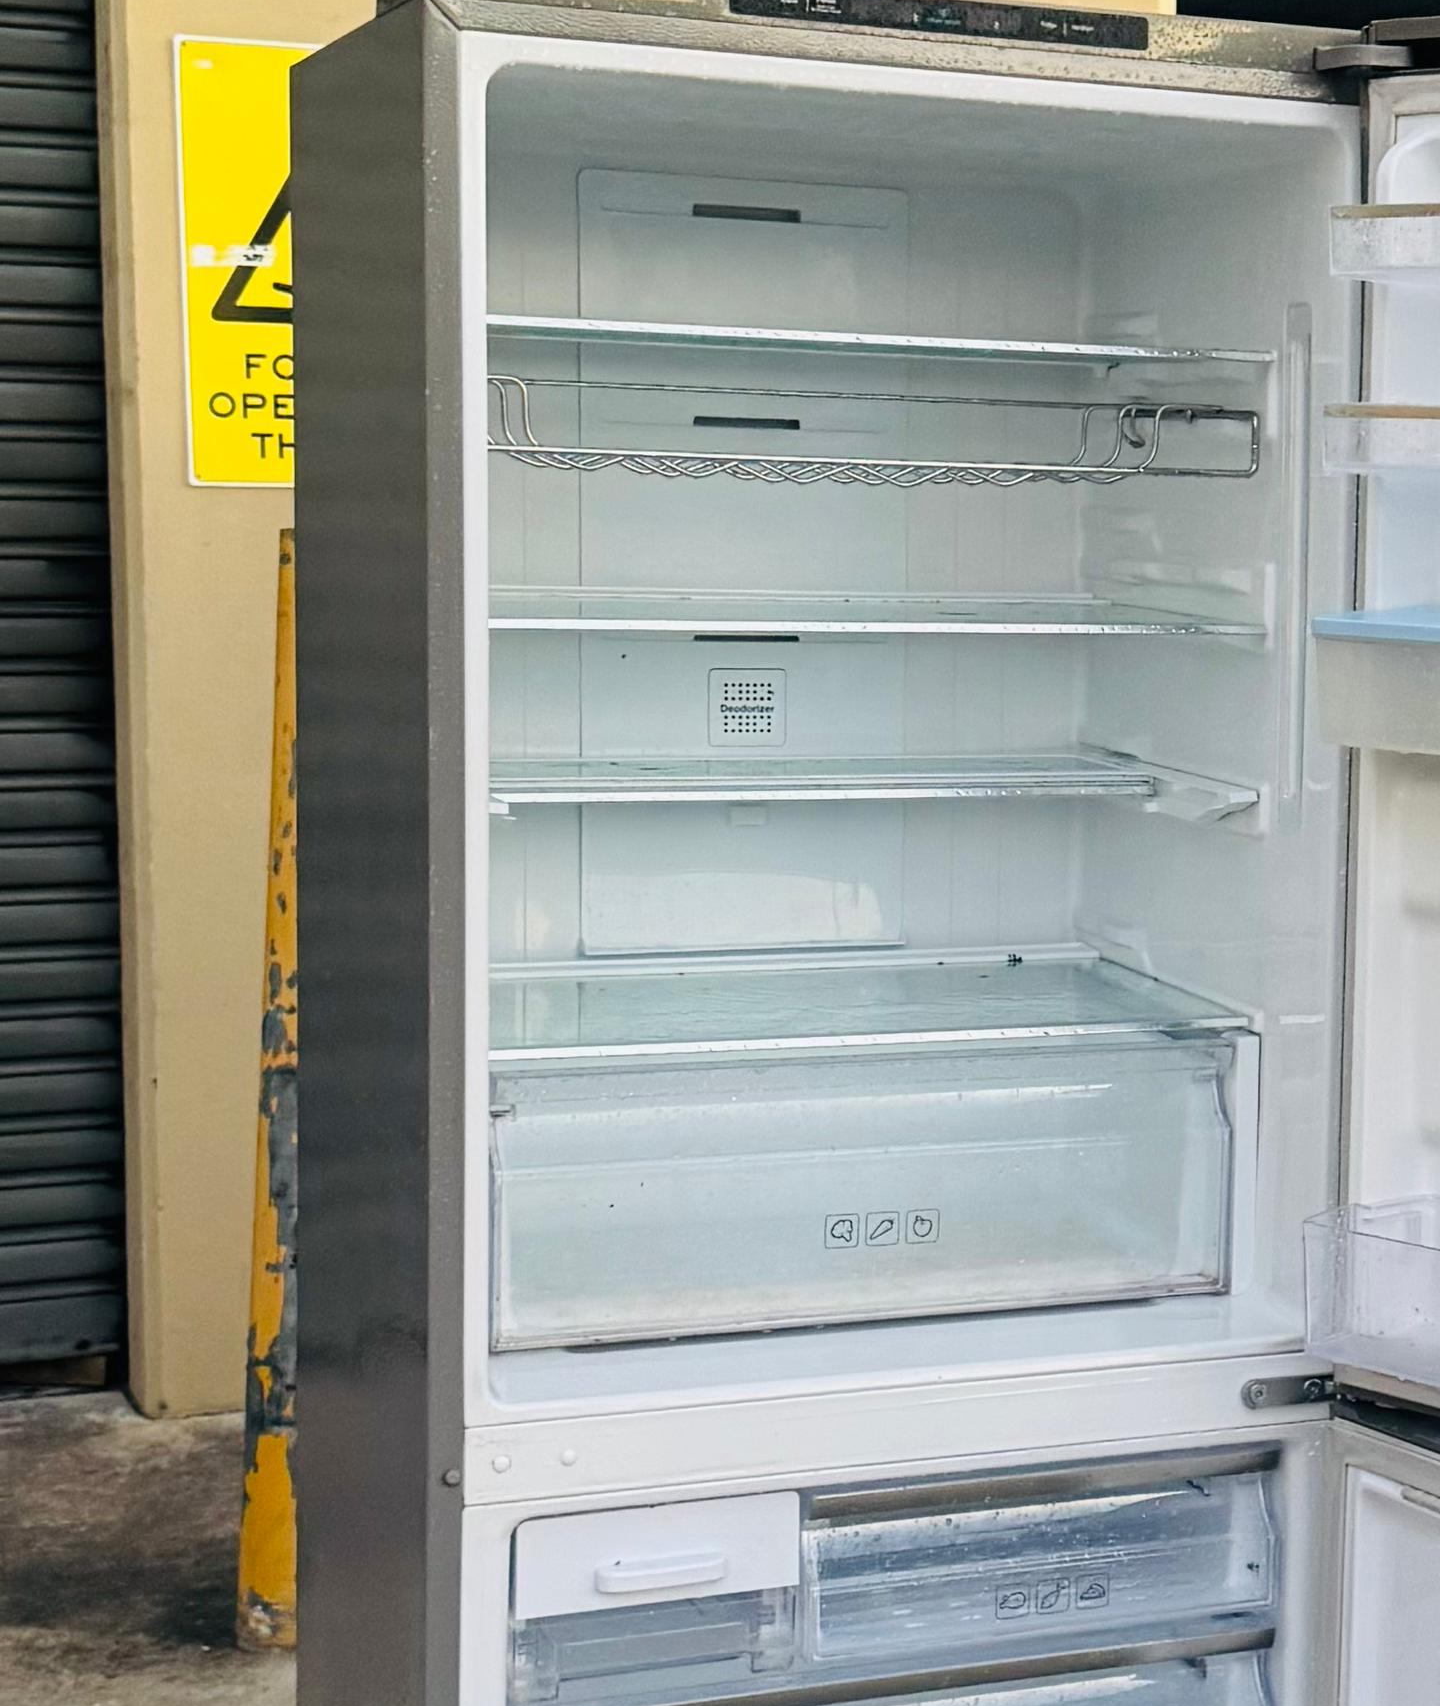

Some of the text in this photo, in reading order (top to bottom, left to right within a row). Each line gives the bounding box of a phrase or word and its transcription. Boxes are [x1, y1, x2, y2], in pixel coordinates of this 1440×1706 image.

[245, 353, 294, 380] FO
[209, 392, 295, 419] OPE
[720, 704, 774, 713] Deodorizer
